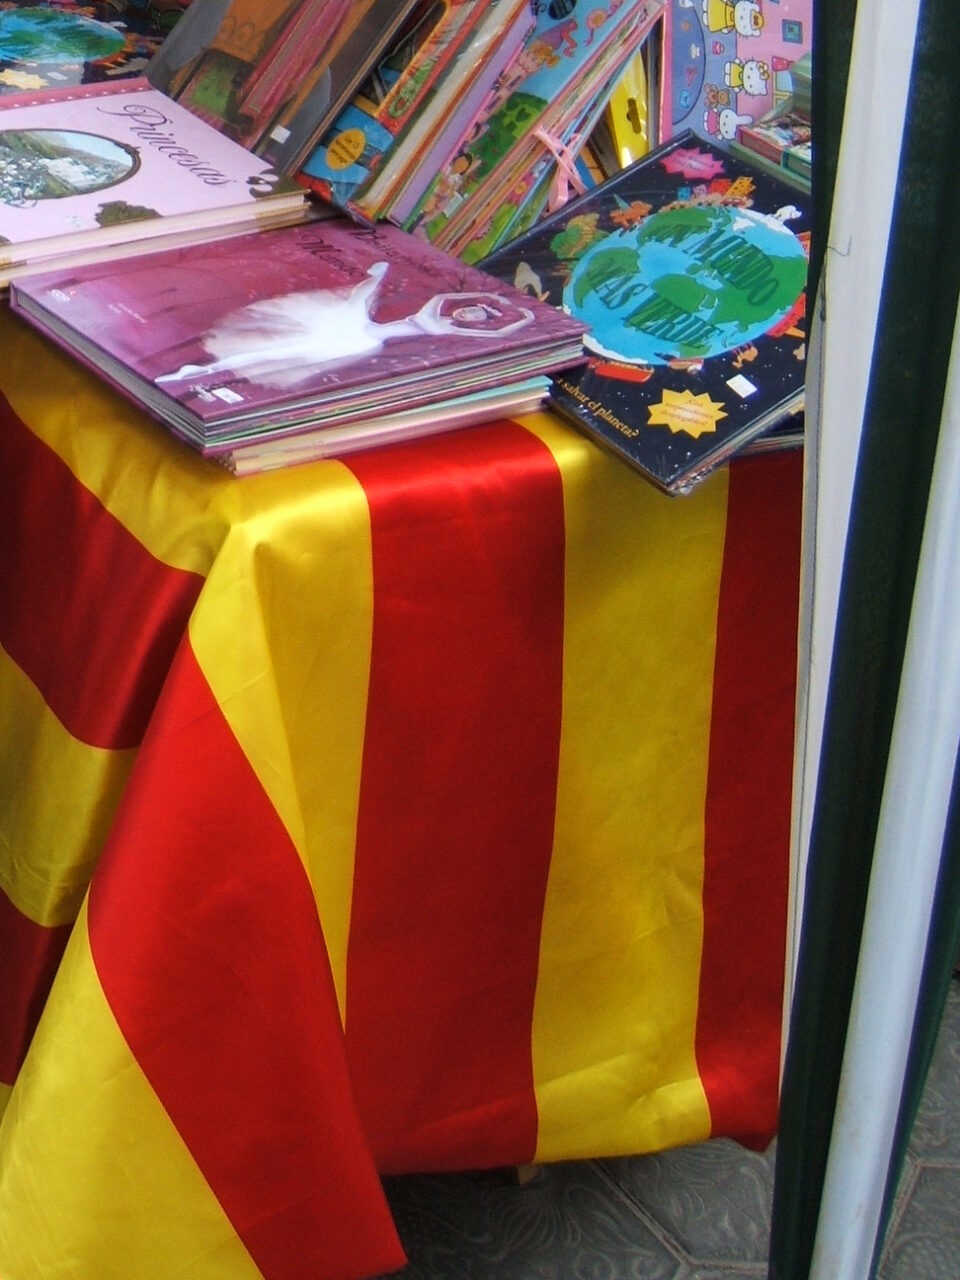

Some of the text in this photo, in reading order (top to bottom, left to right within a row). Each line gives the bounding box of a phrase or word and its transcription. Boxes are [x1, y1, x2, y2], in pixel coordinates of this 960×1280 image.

[96, 104, 237, 185] Princesas
[681, 228, 780, 306] MUNDO
[620, 291, 724, 349] VERDE
[562, 382, 591, 404] salvar
[587, 400, 602, 411] el
[593, 407, 640, 439] planeta?
